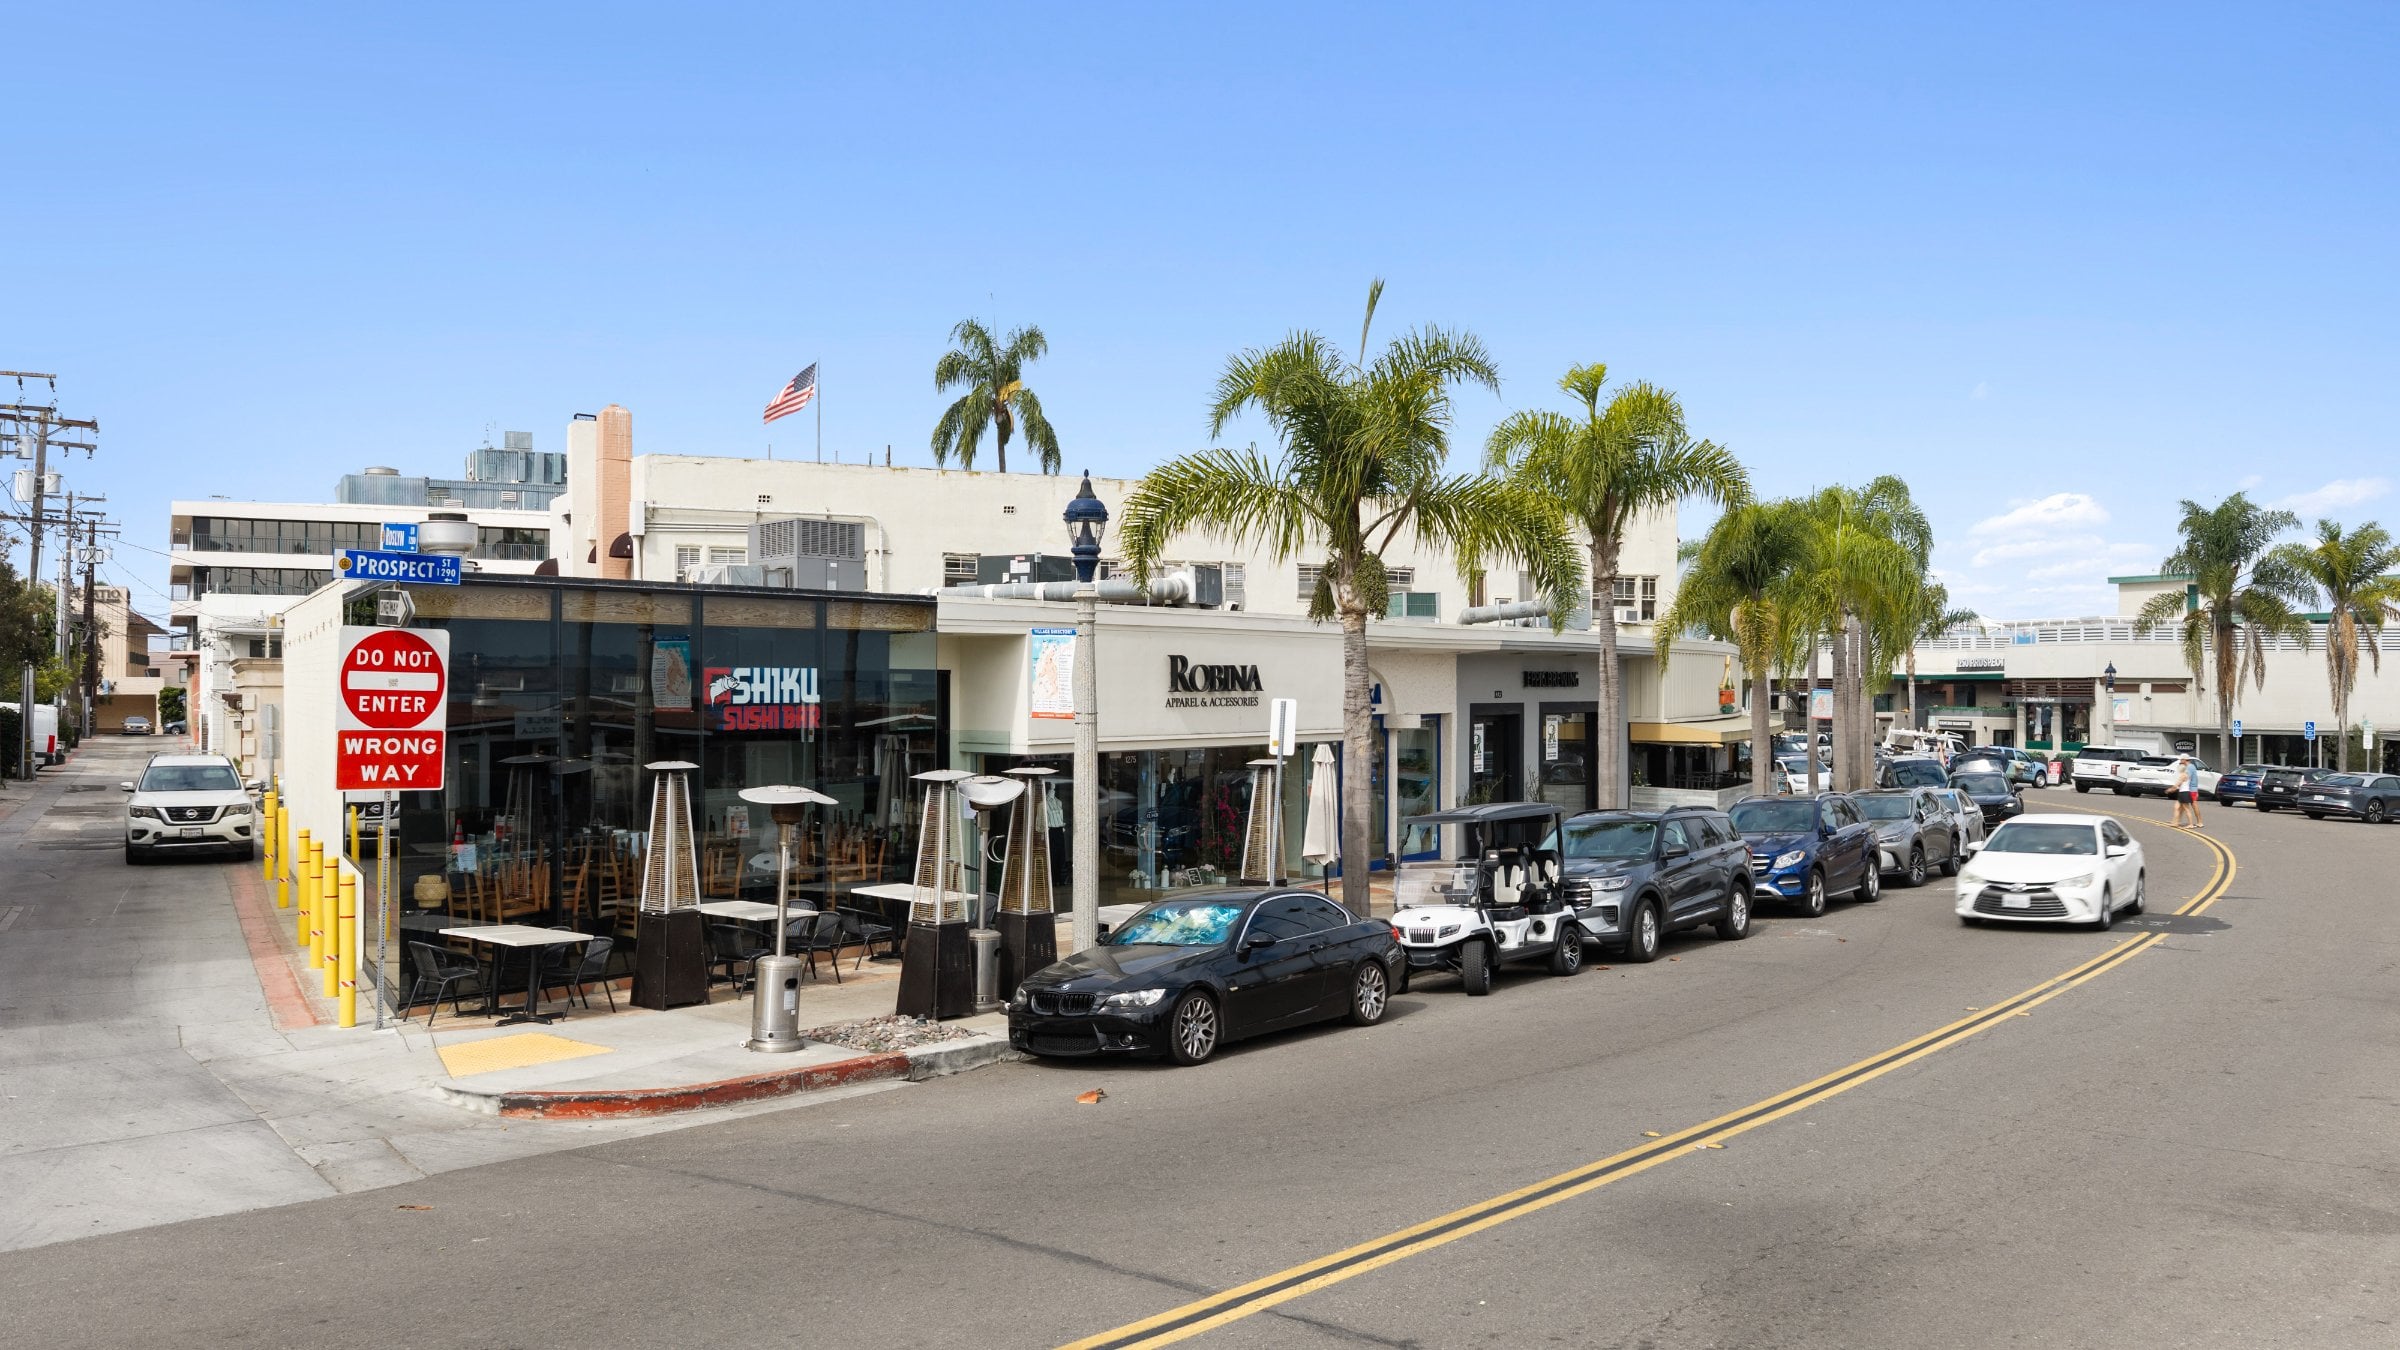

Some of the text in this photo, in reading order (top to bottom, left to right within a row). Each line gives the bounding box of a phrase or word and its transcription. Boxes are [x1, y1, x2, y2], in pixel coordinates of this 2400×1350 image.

[385, 527, 404, 546] ROSLYN
[356, 555, 451, 578] PROSPECT ST
[436, 568, 456, 577] 1290
[356, 648, 433, 668] DO NOT
[1970, 657, 2005, 668] PROSPECT
[1167, 654, 1264, 692] ROBINA
[732, 667, 821, 704] SHIKU
[358, 695, 426, 713] ENTER
[1165, 696, 1259, 708] APPAREL & ACCESSORIES
[723, 705, 821, 730] SUSHI BAR
[344, 737, 438, 755] WRONG
[1125, 755, 1137, 764] 1275
[360, 764, 420, 782] WAY
